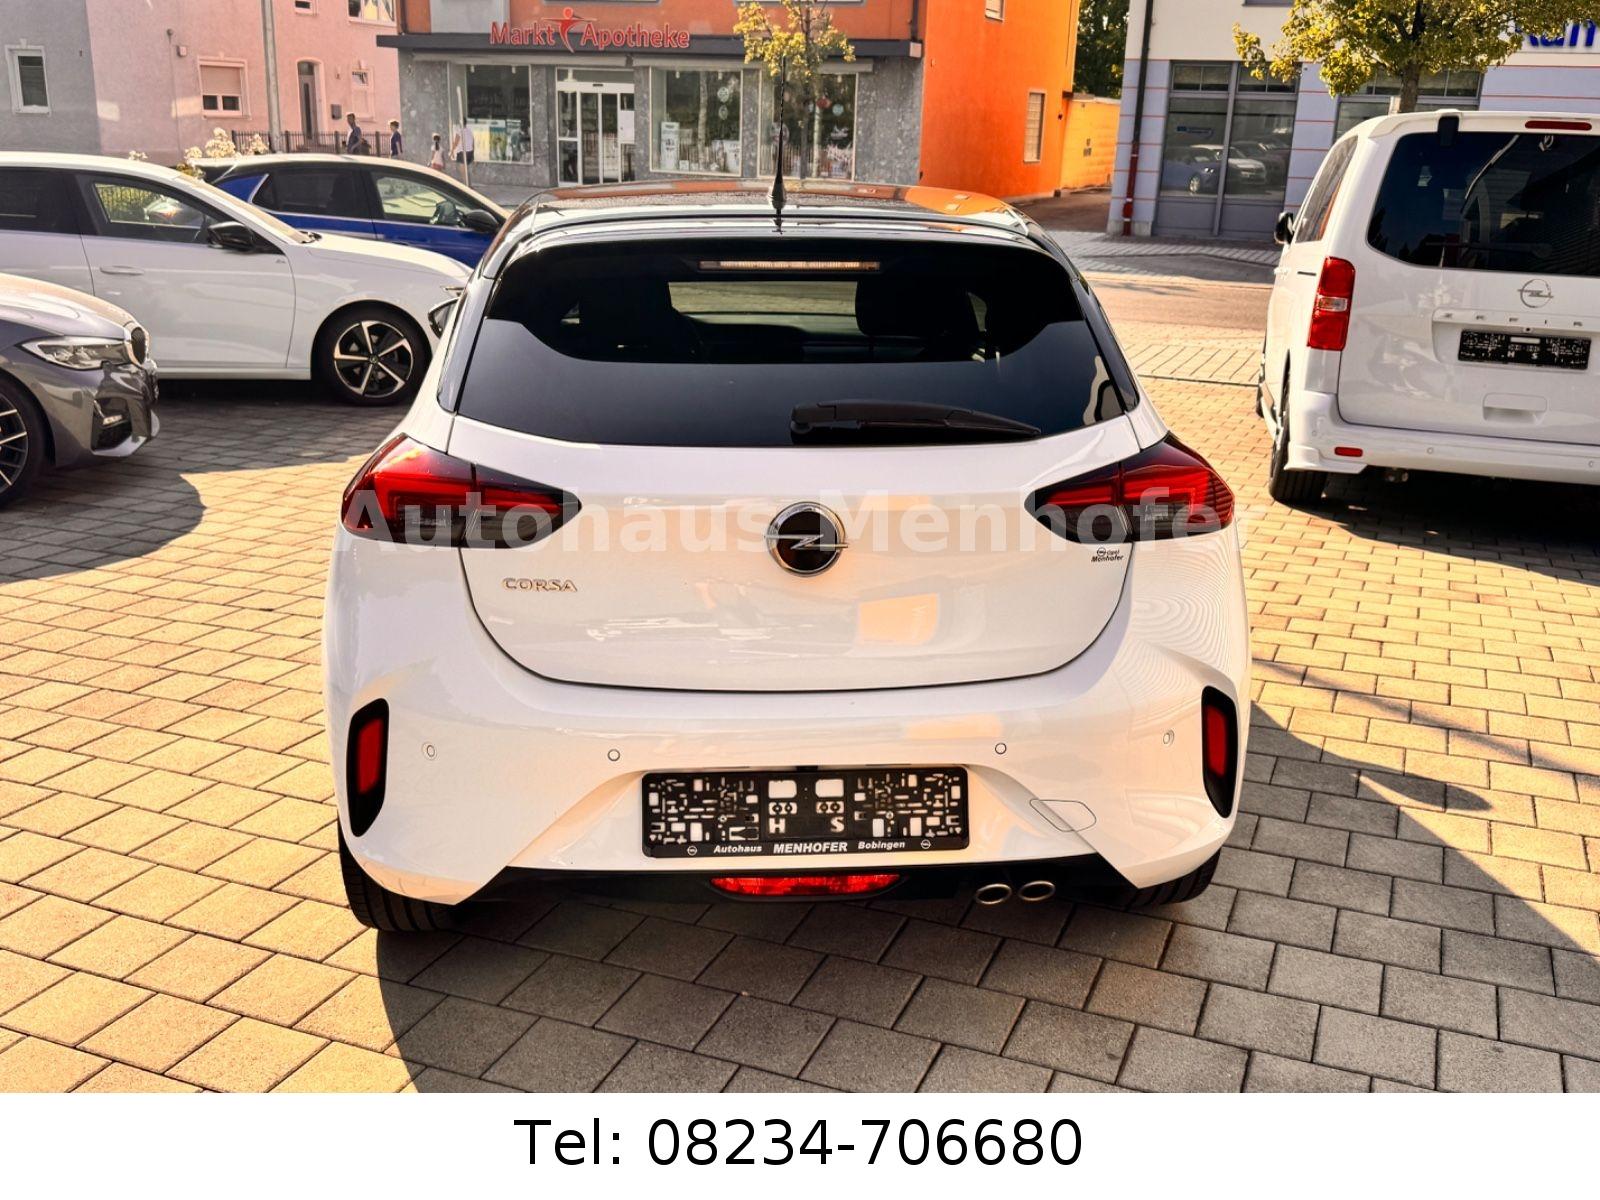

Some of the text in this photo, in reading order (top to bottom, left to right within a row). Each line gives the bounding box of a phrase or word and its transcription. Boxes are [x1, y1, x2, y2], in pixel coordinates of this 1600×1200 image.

[490, 21, 690, 50] Markt Apotheke
[503, 578, 578, 591] CORSA
[713, 840, 906, 854] Autohaus MENHOFER Bobingen
